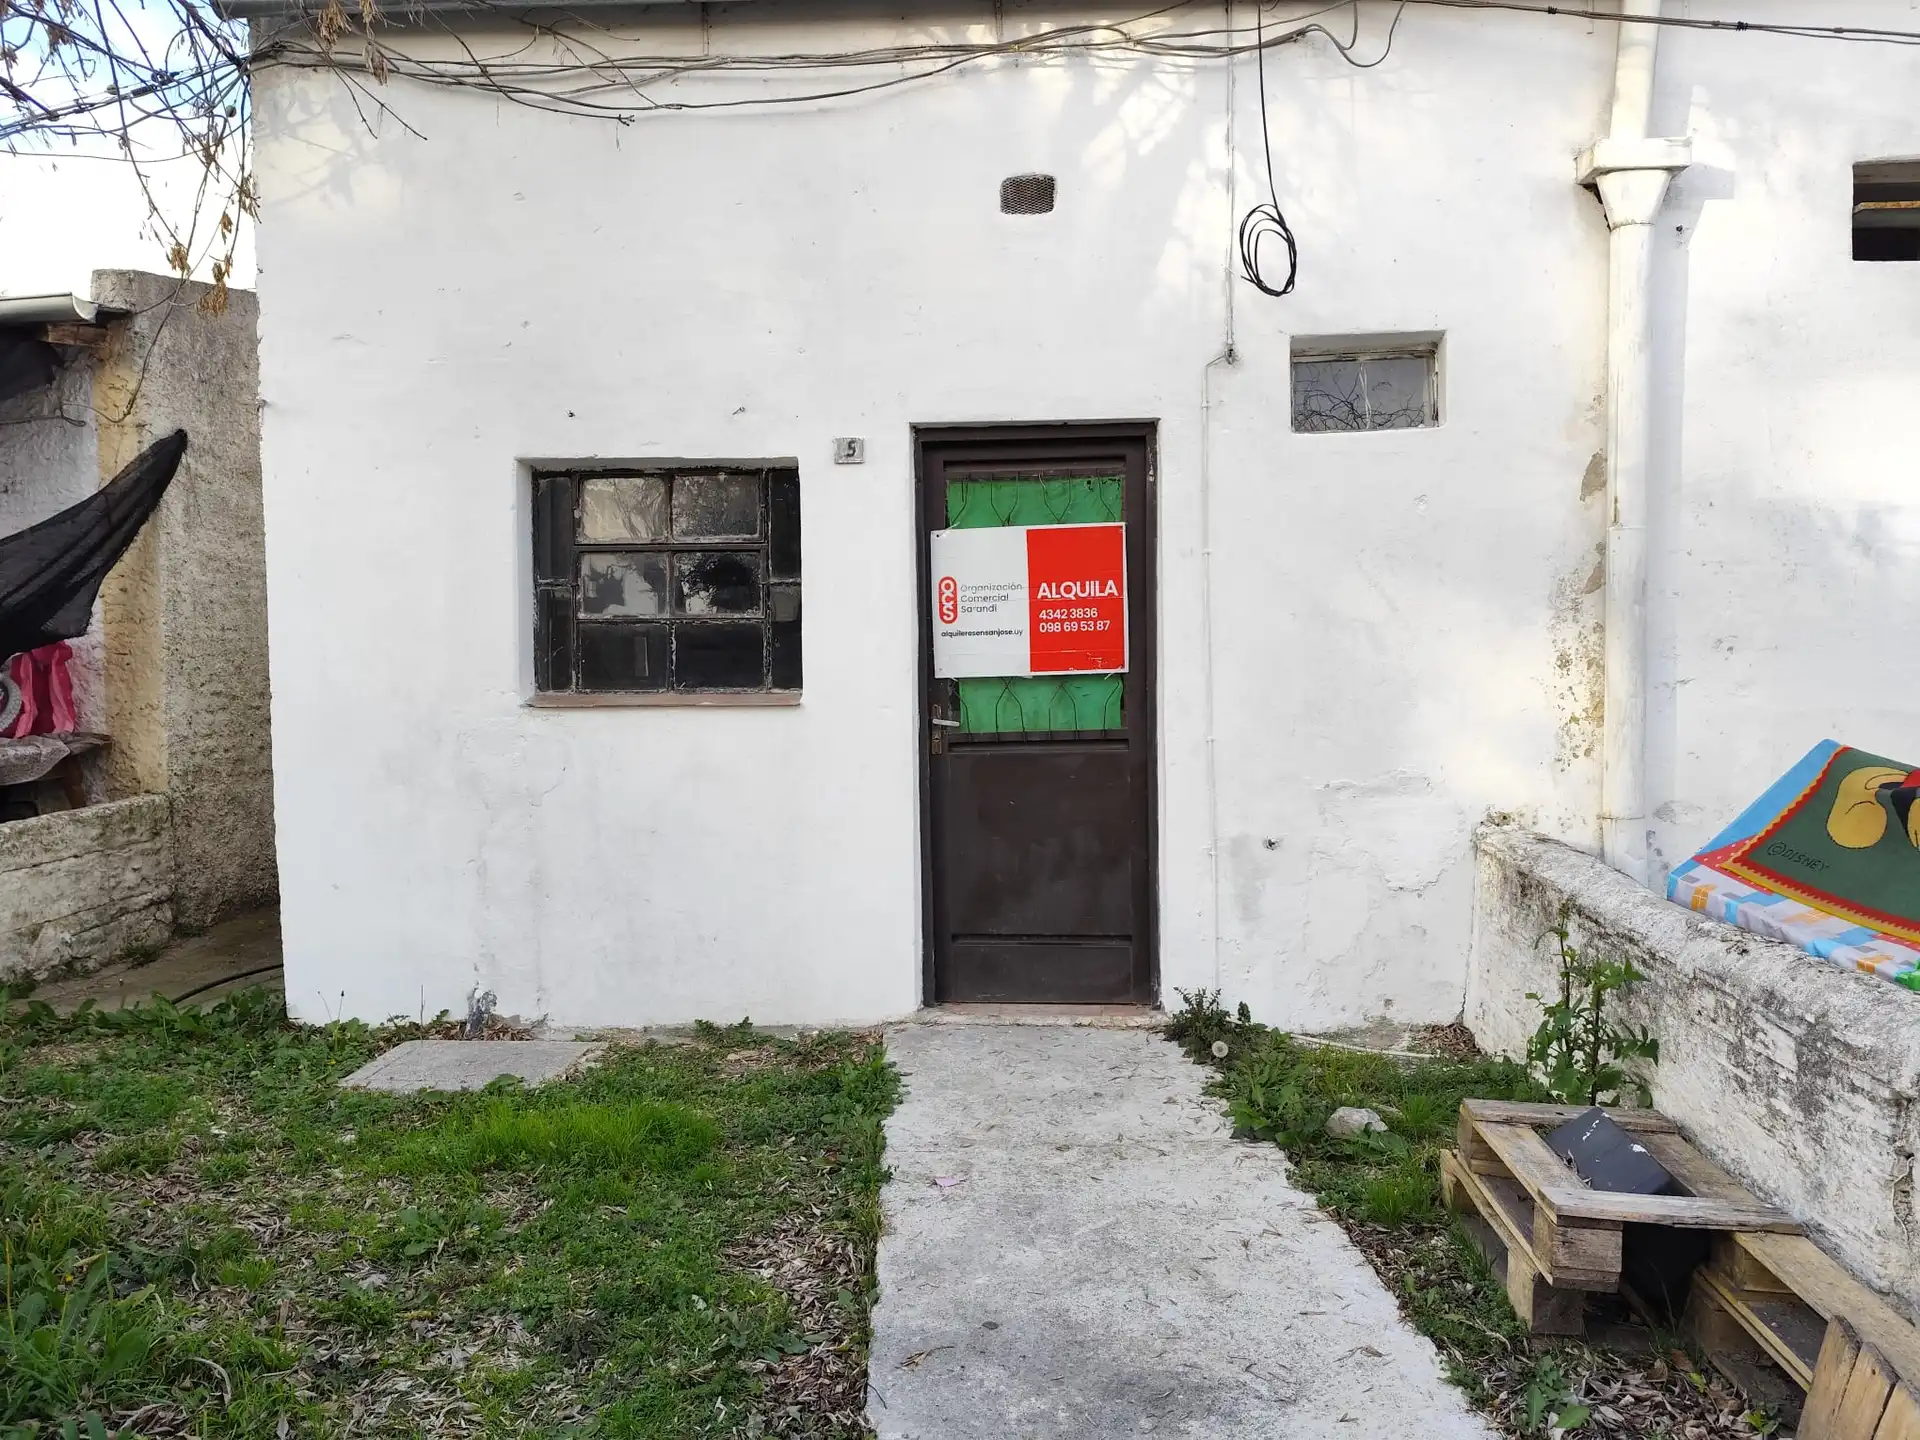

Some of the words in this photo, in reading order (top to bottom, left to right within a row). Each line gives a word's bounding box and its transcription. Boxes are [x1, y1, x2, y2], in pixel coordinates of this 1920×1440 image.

[844, 440, 857, 458] 5
[960, 582, 1023, 594] Organización
[1037, 579, 1119, 600] ALQUILA
[960, 593, 1009, 603] Comercial
[1039, 608, 1068, 620] 4342
[1069, 607, 1098, 619] 3836
[1039, 621, 1061, 633] 098
[1063, 621, 1078, 632] 69
[1080, 620, 1095, 631] 53
[1096, 619, 1111, 631] 87
[941, 627, 1024, 639] alquileresensanjose.uy
